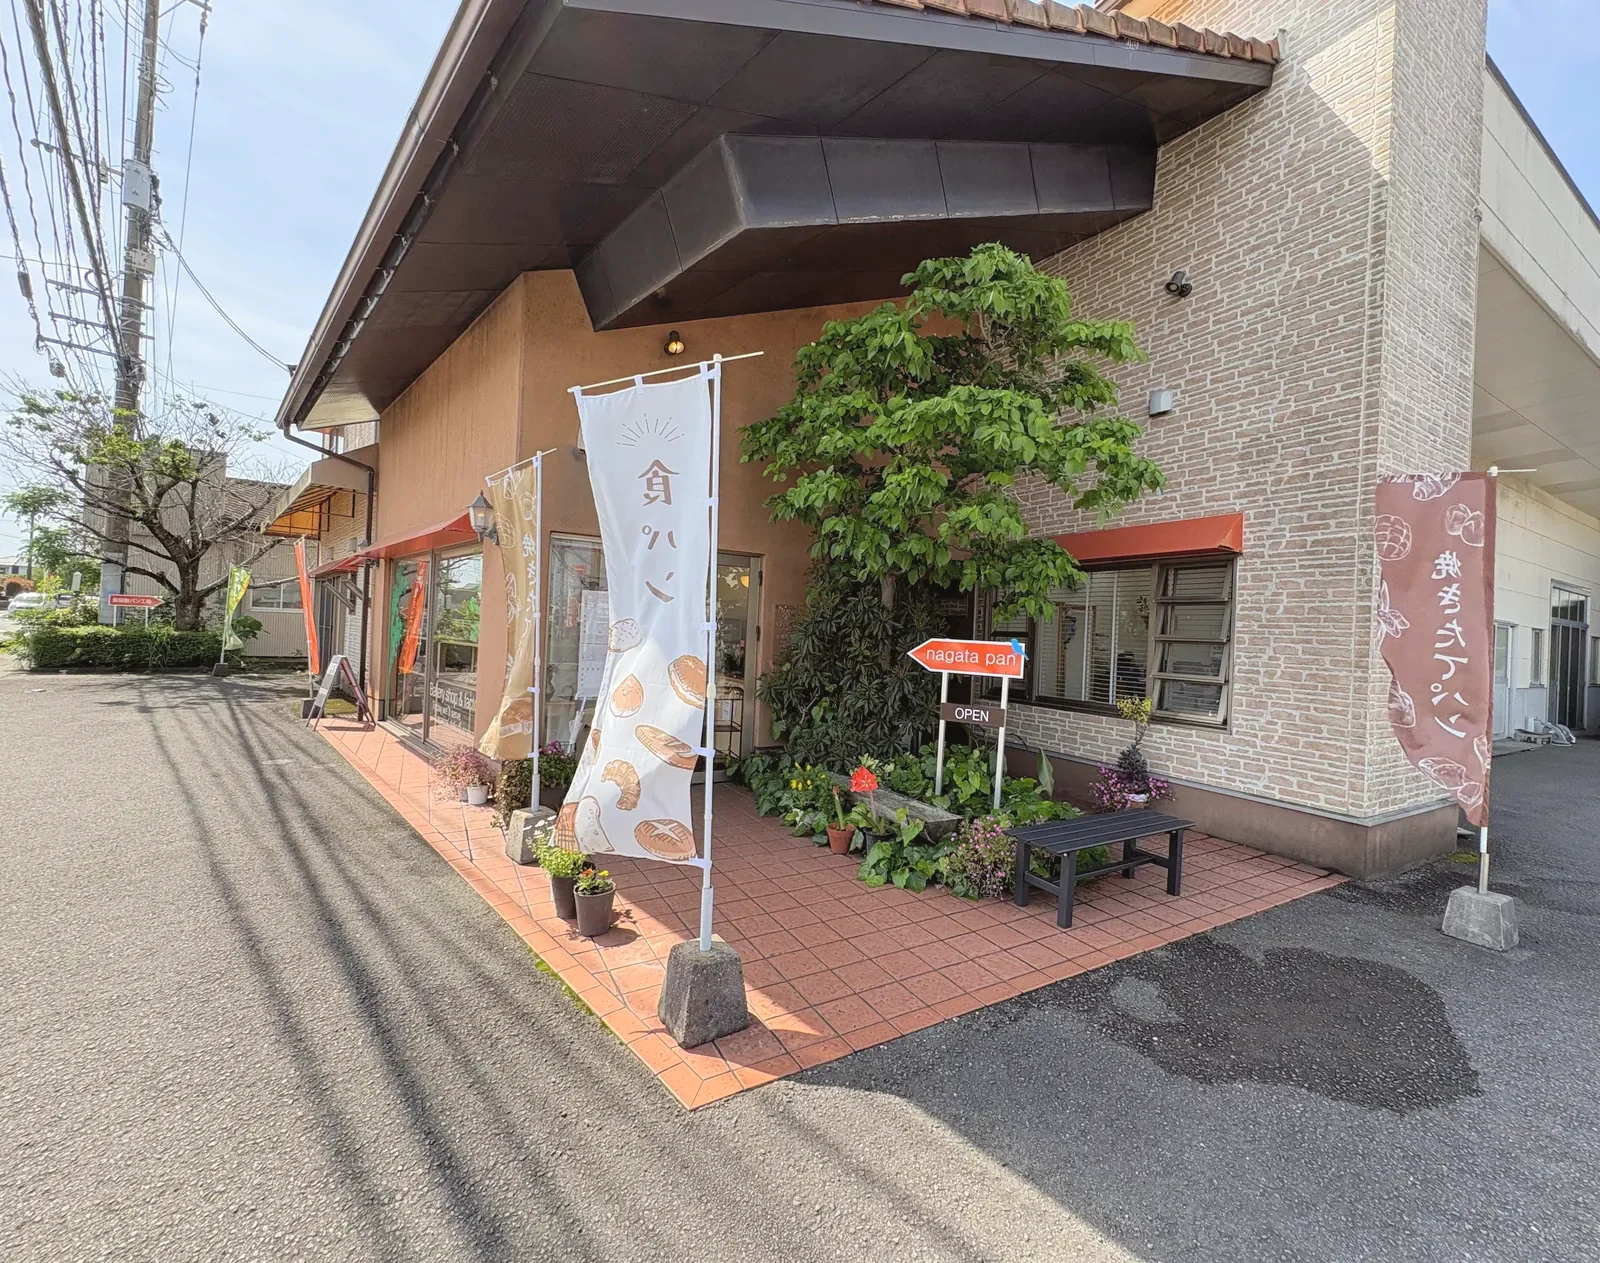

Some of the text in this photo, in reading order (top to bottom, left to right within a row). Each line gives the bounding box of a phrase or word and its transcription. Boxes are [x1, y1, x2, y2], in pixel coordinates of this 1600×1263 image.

[926, 649, 1016, 667] nagata pan
[445, 687, 458, 708] shop
[459, 691, 463, 706] &
[954, 707, 990, 722] OPEN
